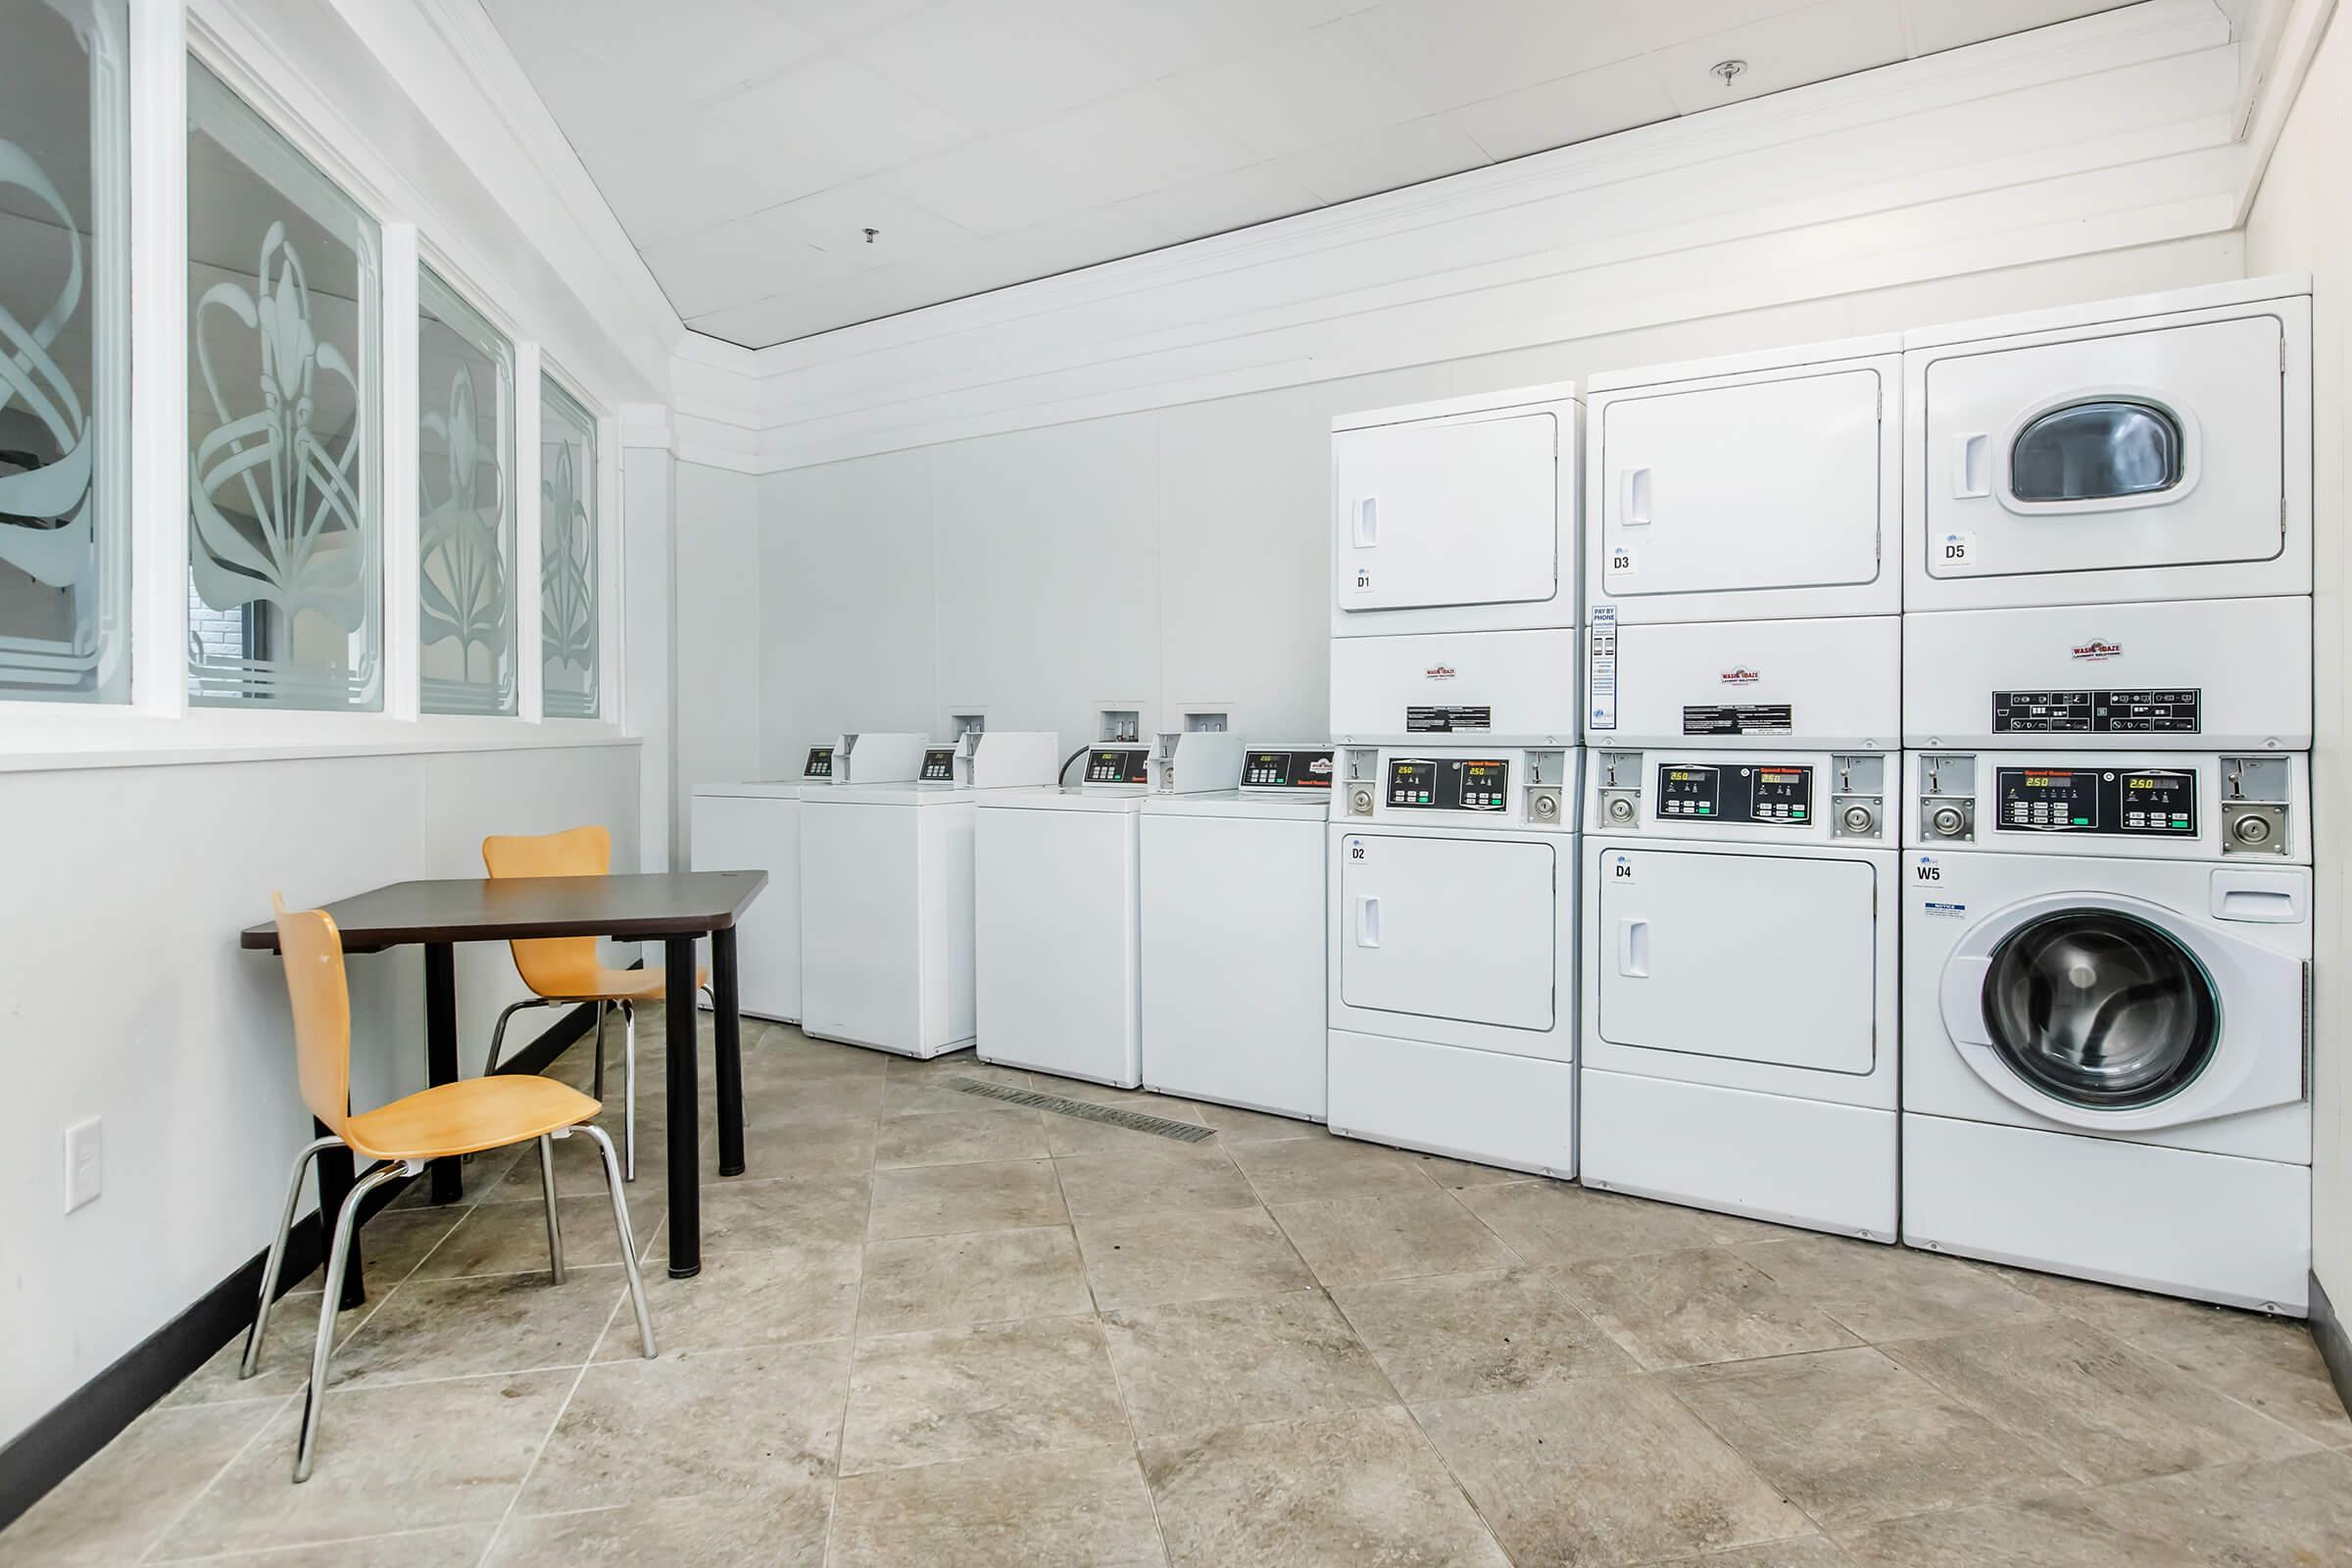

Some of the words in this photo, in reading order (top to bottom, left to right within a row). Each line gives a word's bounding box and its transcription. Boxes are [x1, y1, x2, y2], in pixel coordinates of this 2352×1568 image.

[1945, 545, 1965, 559] D5
[1614, 557, 1630, 569] D3
[1357, 576, 1370, 588] D1
[1352, 848, 1365, 859] D2
[1616, 864, 1632, 878] D4
[1917, 866, 1940, 881] W5
